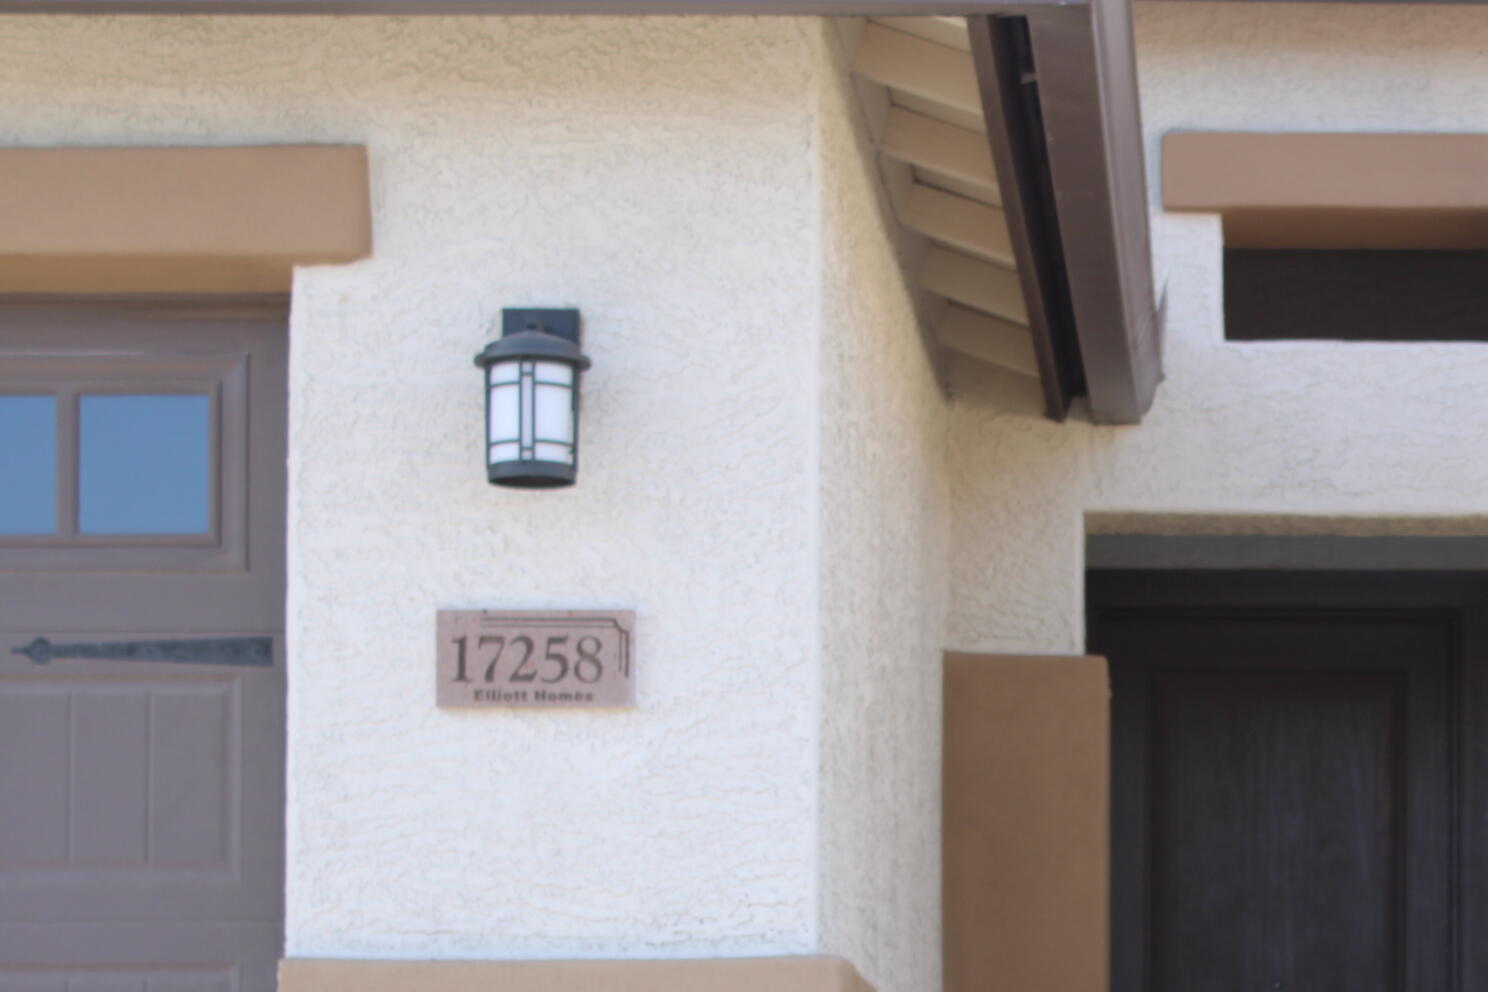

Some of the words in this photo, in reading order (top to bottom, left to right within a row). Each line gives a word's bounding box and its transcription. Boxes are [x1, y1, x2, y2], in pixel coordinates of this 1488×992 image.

[451, 634, 603, 684] 17258
[473, 689, 528, 702] Elliott
[534, 689, 594, 702] Homes
